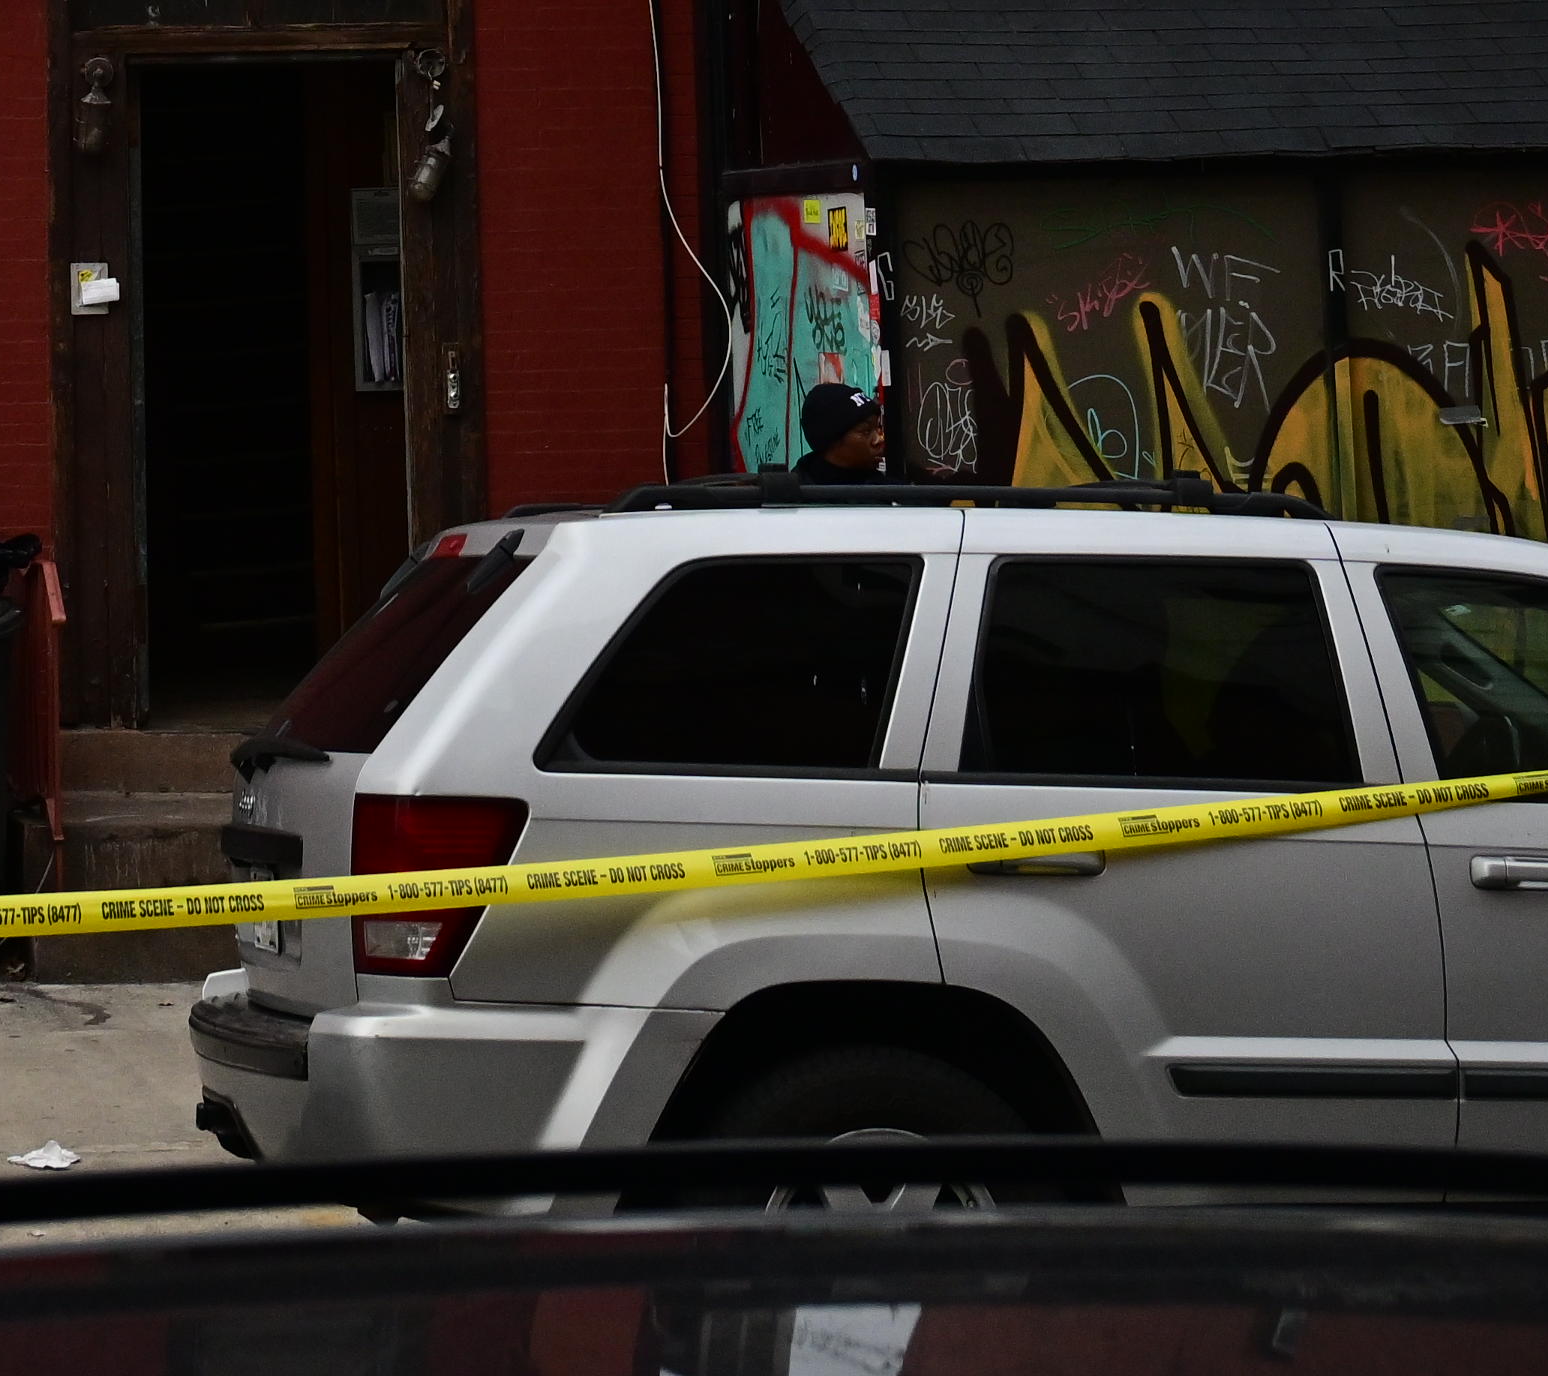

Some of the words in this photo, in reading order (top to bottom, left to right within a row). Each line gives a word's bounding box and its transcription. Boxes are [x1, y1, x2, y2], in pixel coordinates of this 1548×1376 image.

[1338, 793, 1374, 812] CRIME
[1372, 790, 1409, 812] SCENE
[1415, 787, 1434, 807] DO
[1431, 785, 1456, 805] NOT
[1454, 782, 1491, 803] CROSS
[1208, 801, 1292, 825] 1-800-577-TIPS
[1289, 799, 1323, 820] (8477)
[938, 835, 974, 853] CRIME
[971, 832, 1009, 851] SCENE
[1018, 829, 1036, 846] DO
[1034, 827, 1056, 845] NOT
[1057, 824, 1093, 843] CROSS
[803, 843, 887, 865] 1-800-577-TIPS
[887, 840, 921, 860] (8477)
[387, 878, 475, 900] 1-800-577-TIPS
[473, 875, 508, 899] (8477)
[526, 871, 564, 890] CRIME
[562, 869, 598, 887] SCENE
[608, 867, 624, 884] DO
[625, 865, 647, 882] NOT
[649, 862, 685, 881] CROSS
[46, 902, 81, 925] (8477)
[100, 899, 137, 920] CRIME
[138, 898, 174, 918] SCENE
[185, 896, 202, 915] DO
[203, 895, 225, 914] NOT
[227, 893, 264, 913] CROSS
